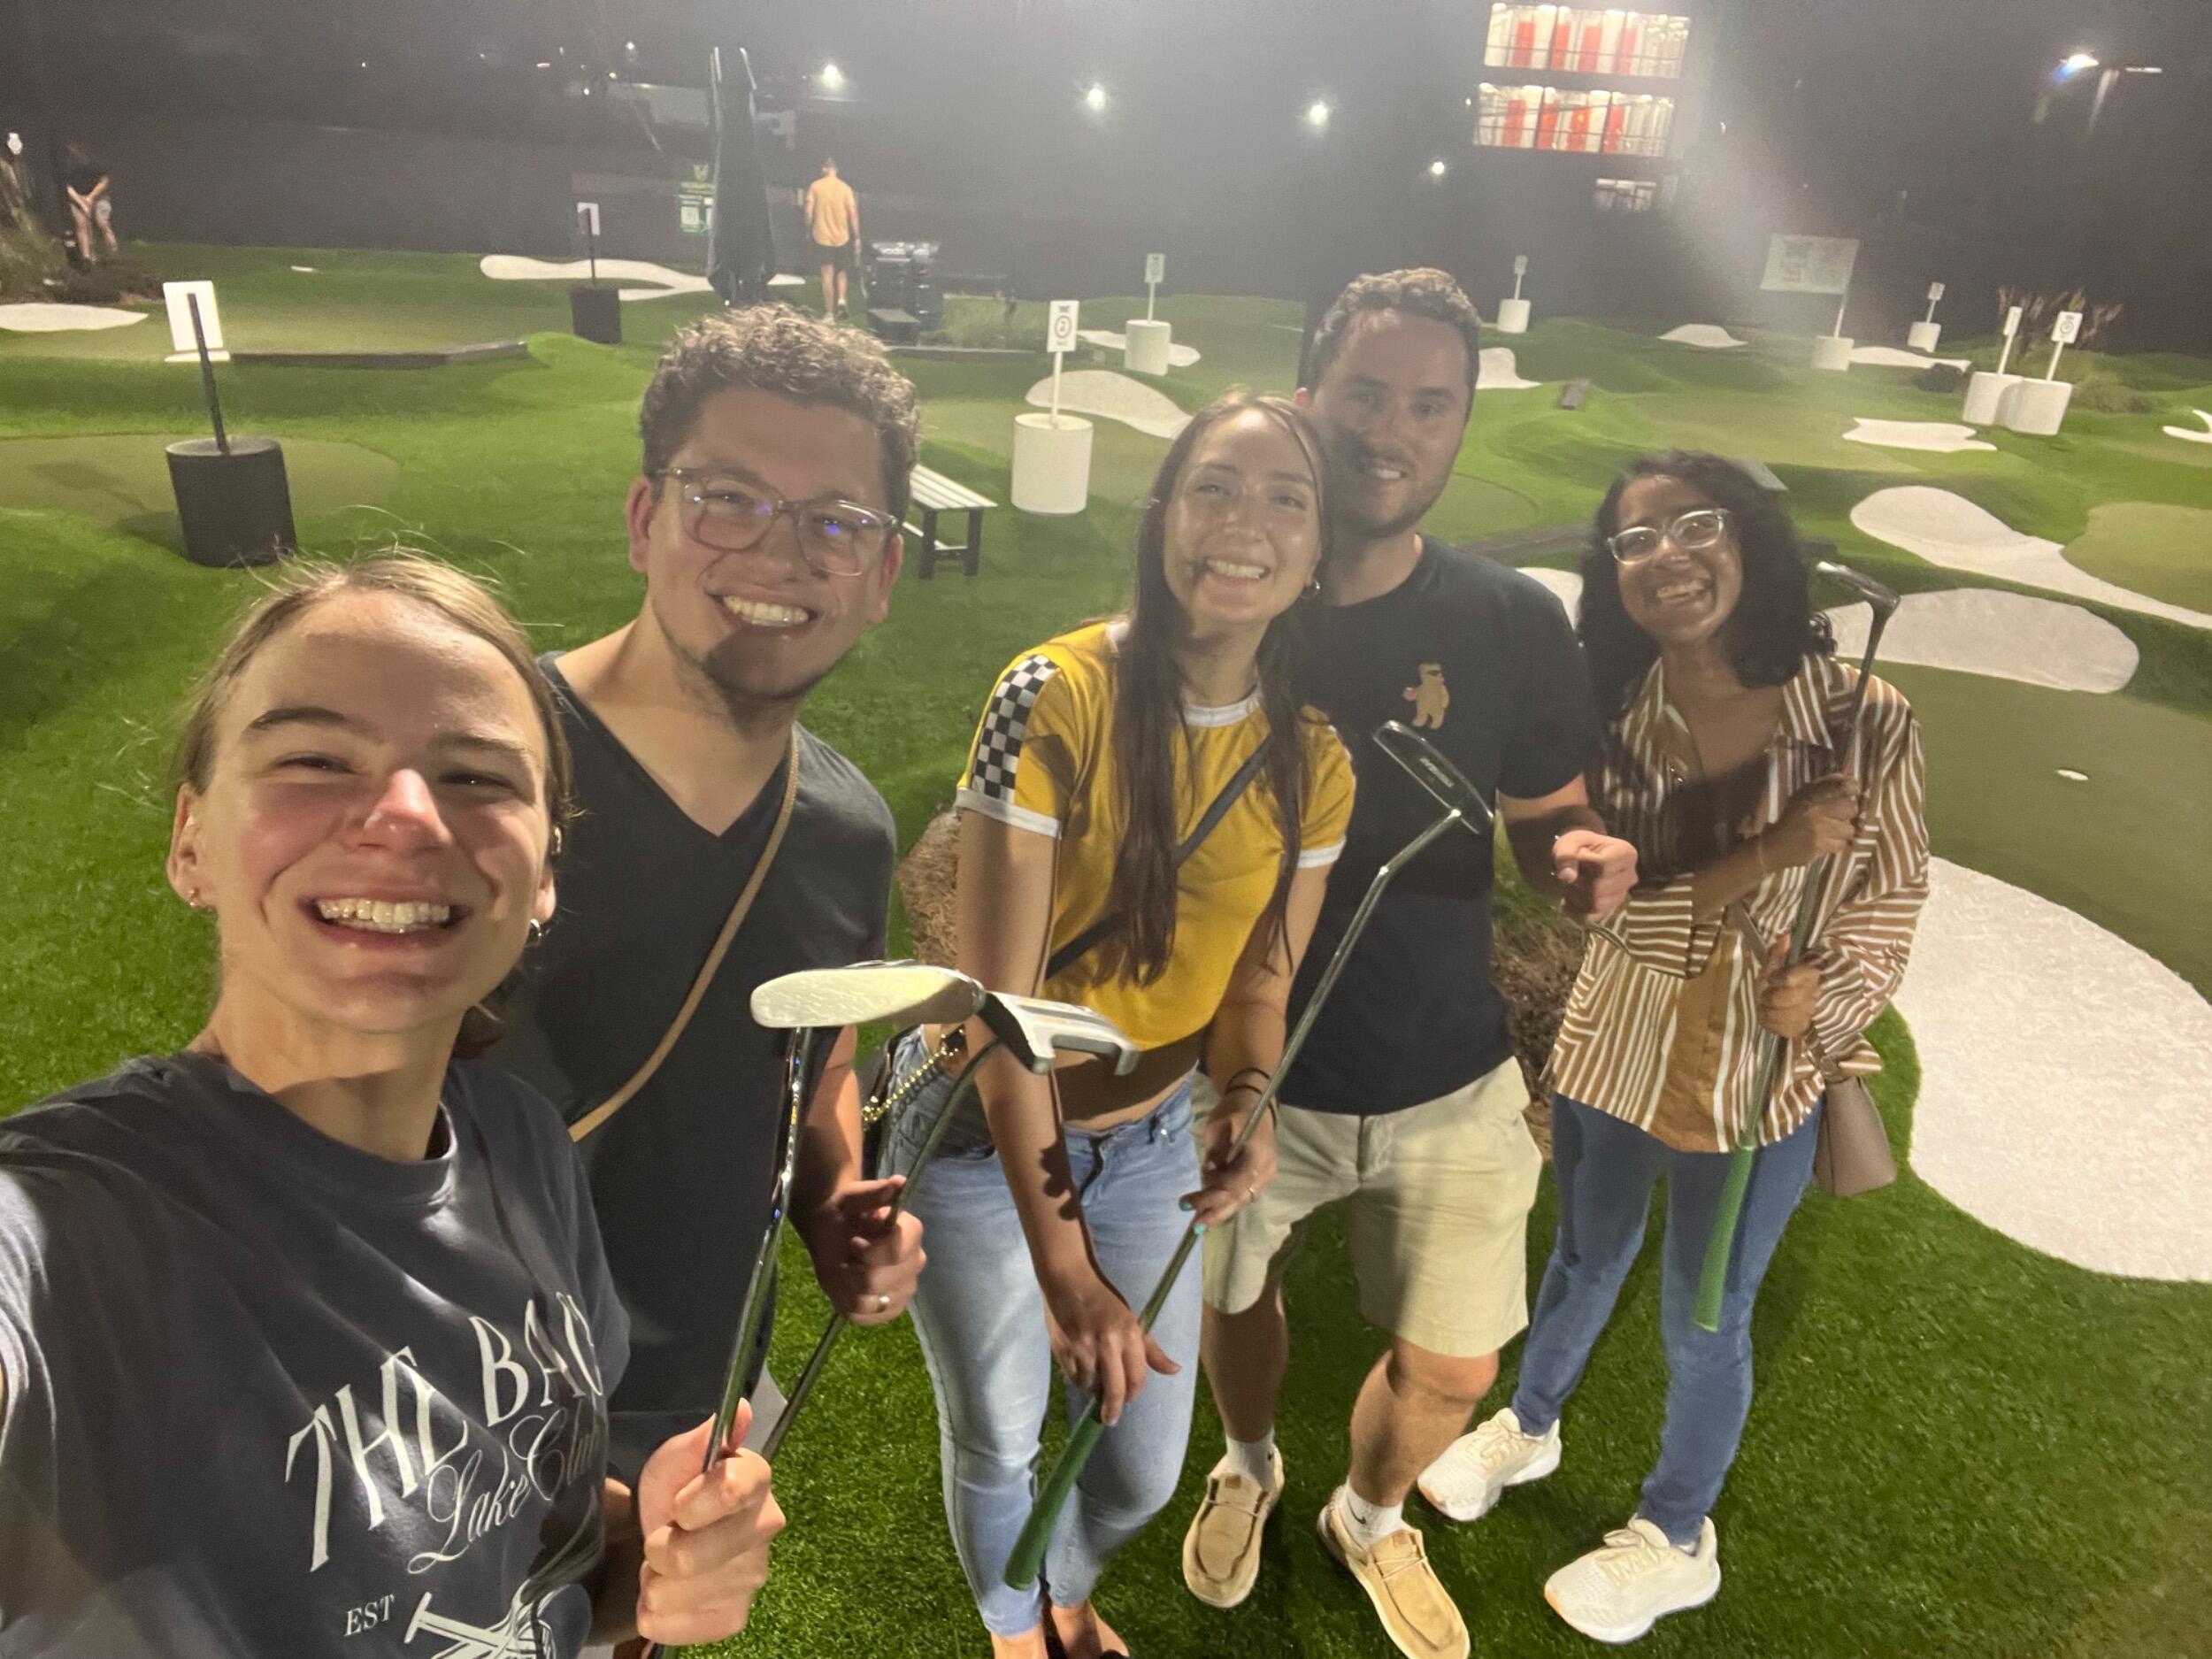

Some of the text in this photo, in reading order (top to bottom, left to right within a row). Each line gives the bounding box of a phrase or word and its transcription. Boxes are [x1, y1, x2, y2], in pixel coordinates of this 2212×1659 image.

[285, 1346, 469, 1572] THE
[407, 1448, 531, 1574] Lake
[343, 1594, 395, 1637] EST
